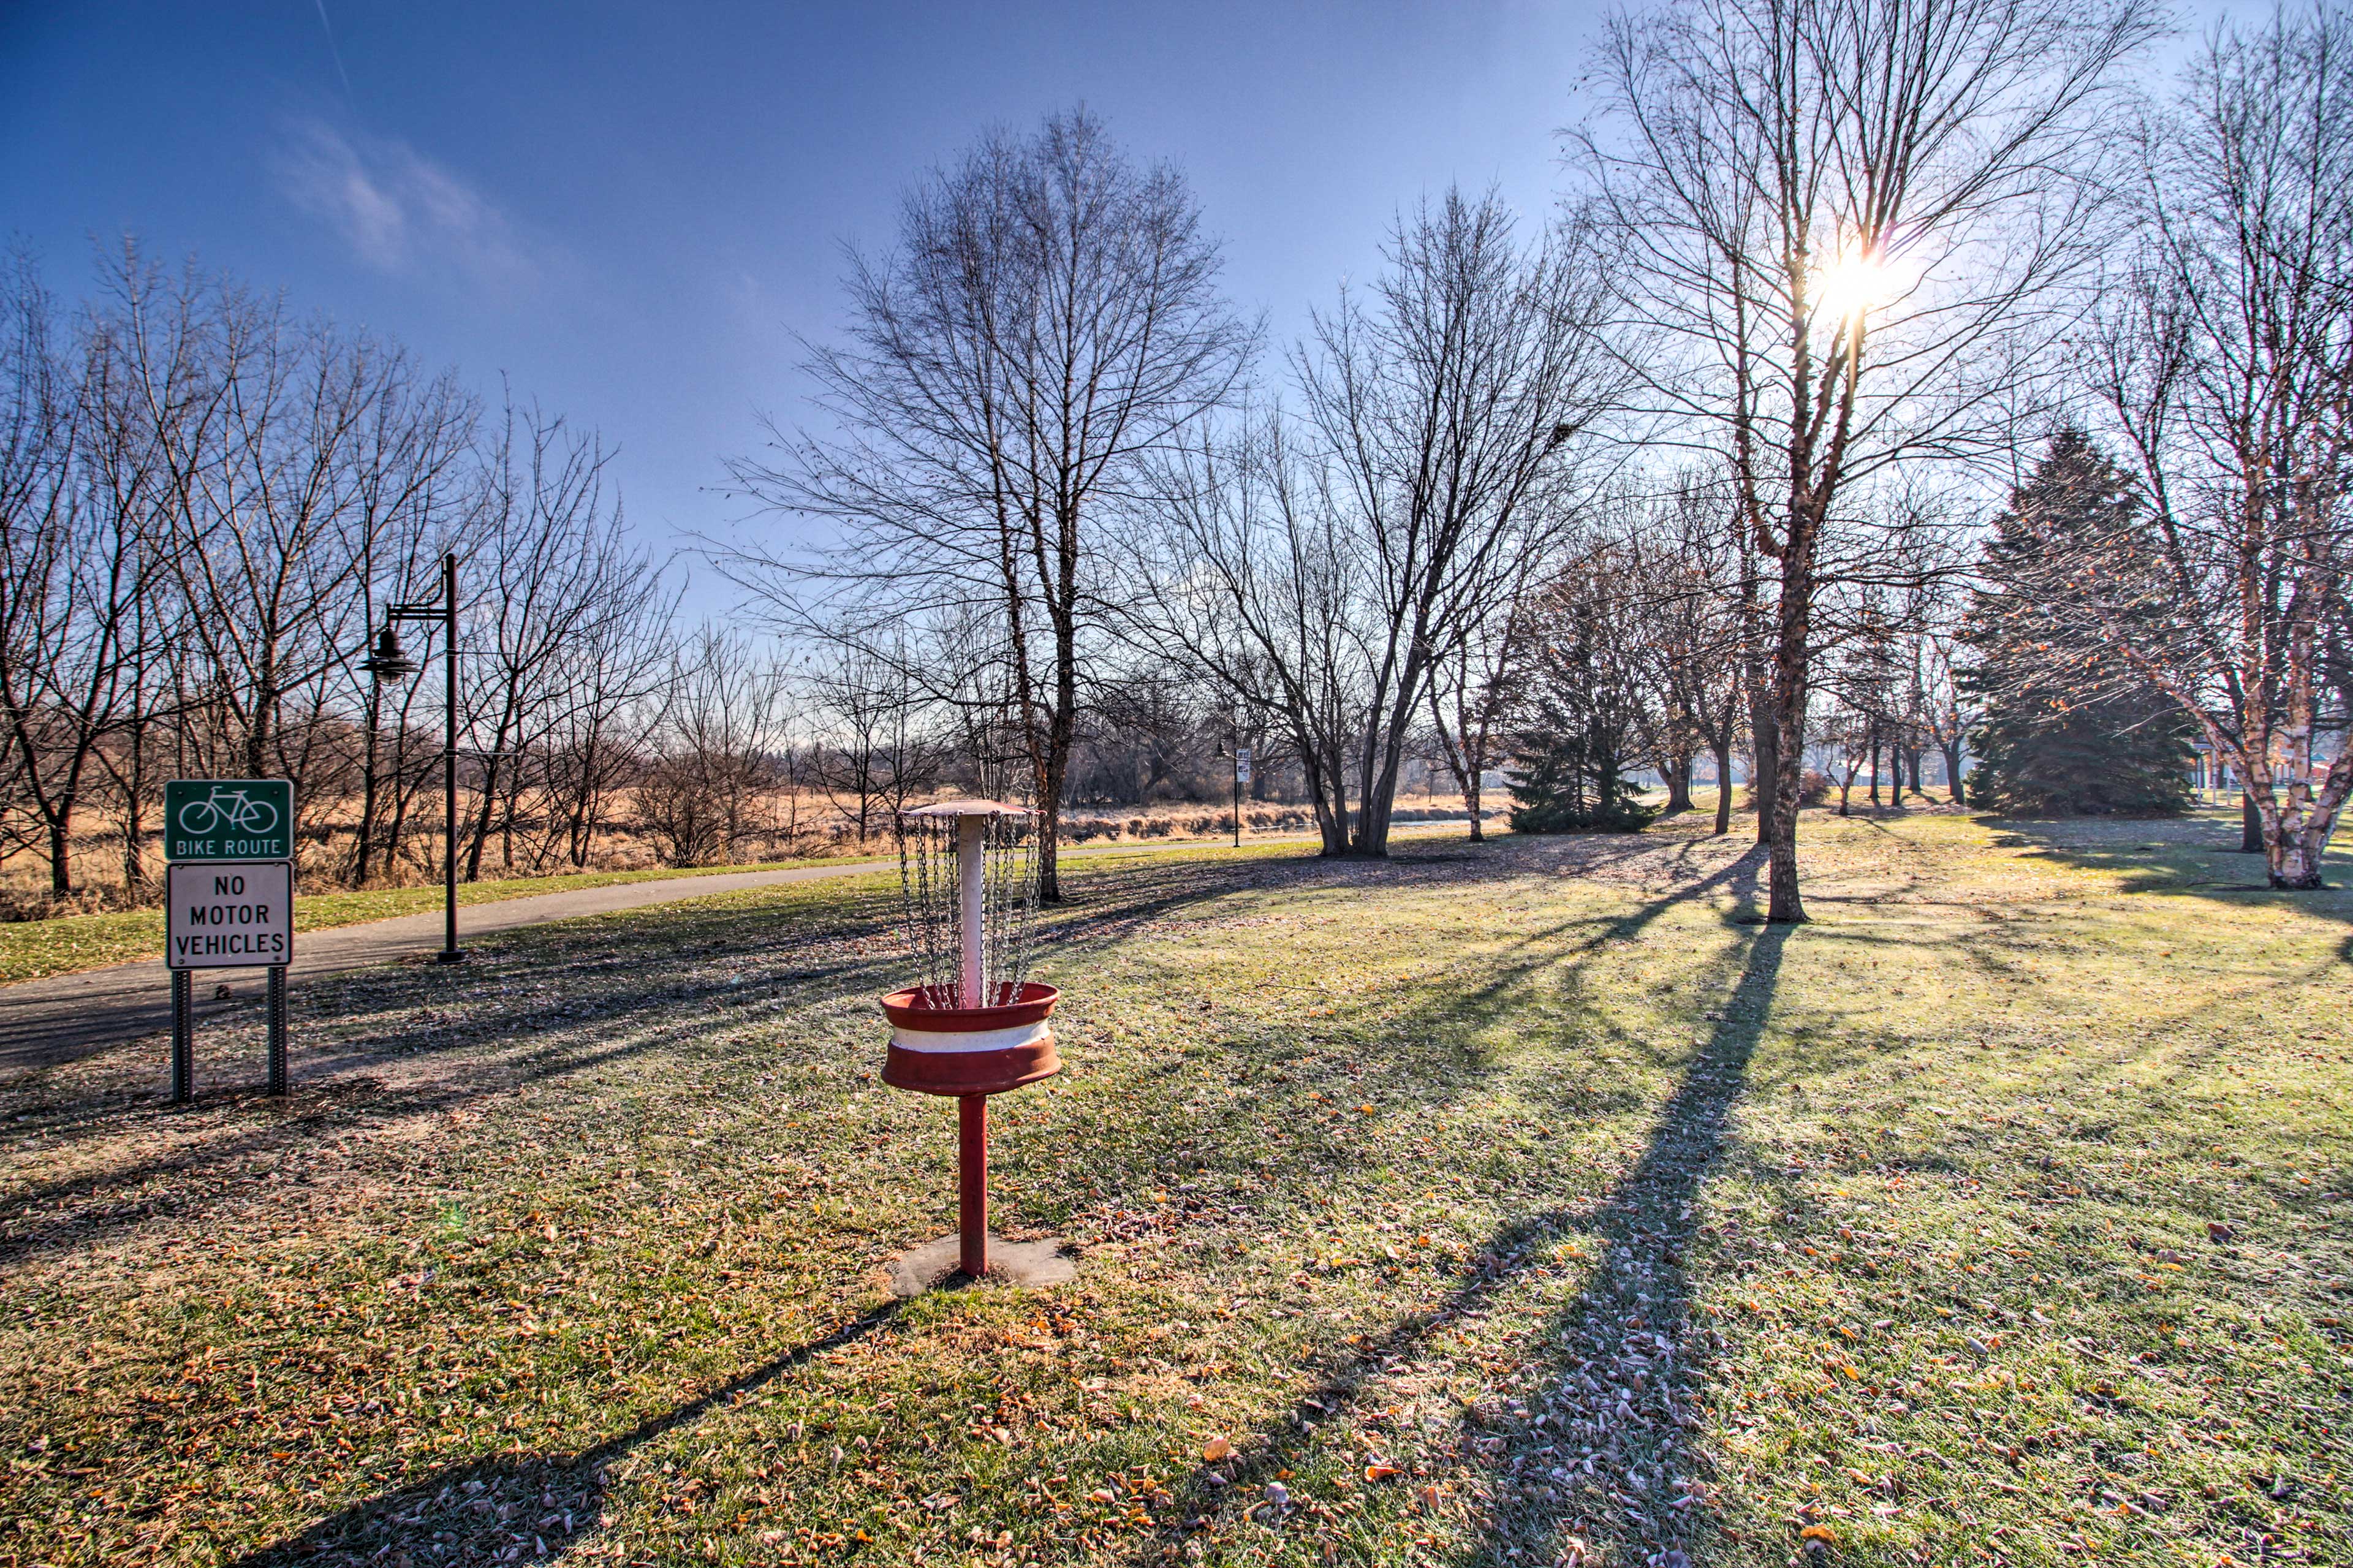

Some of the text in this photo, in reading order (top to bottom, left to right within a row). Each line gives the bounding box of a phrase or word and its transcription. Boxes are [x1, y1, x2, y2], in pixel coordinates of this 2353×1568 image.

[176, 839, 281, 855] BIKE ROUTE
[215, 876, 244, 895] NO
[191, 905, 268, 925] MOTOR
[176, 933, 284, 955] VEHICLES
